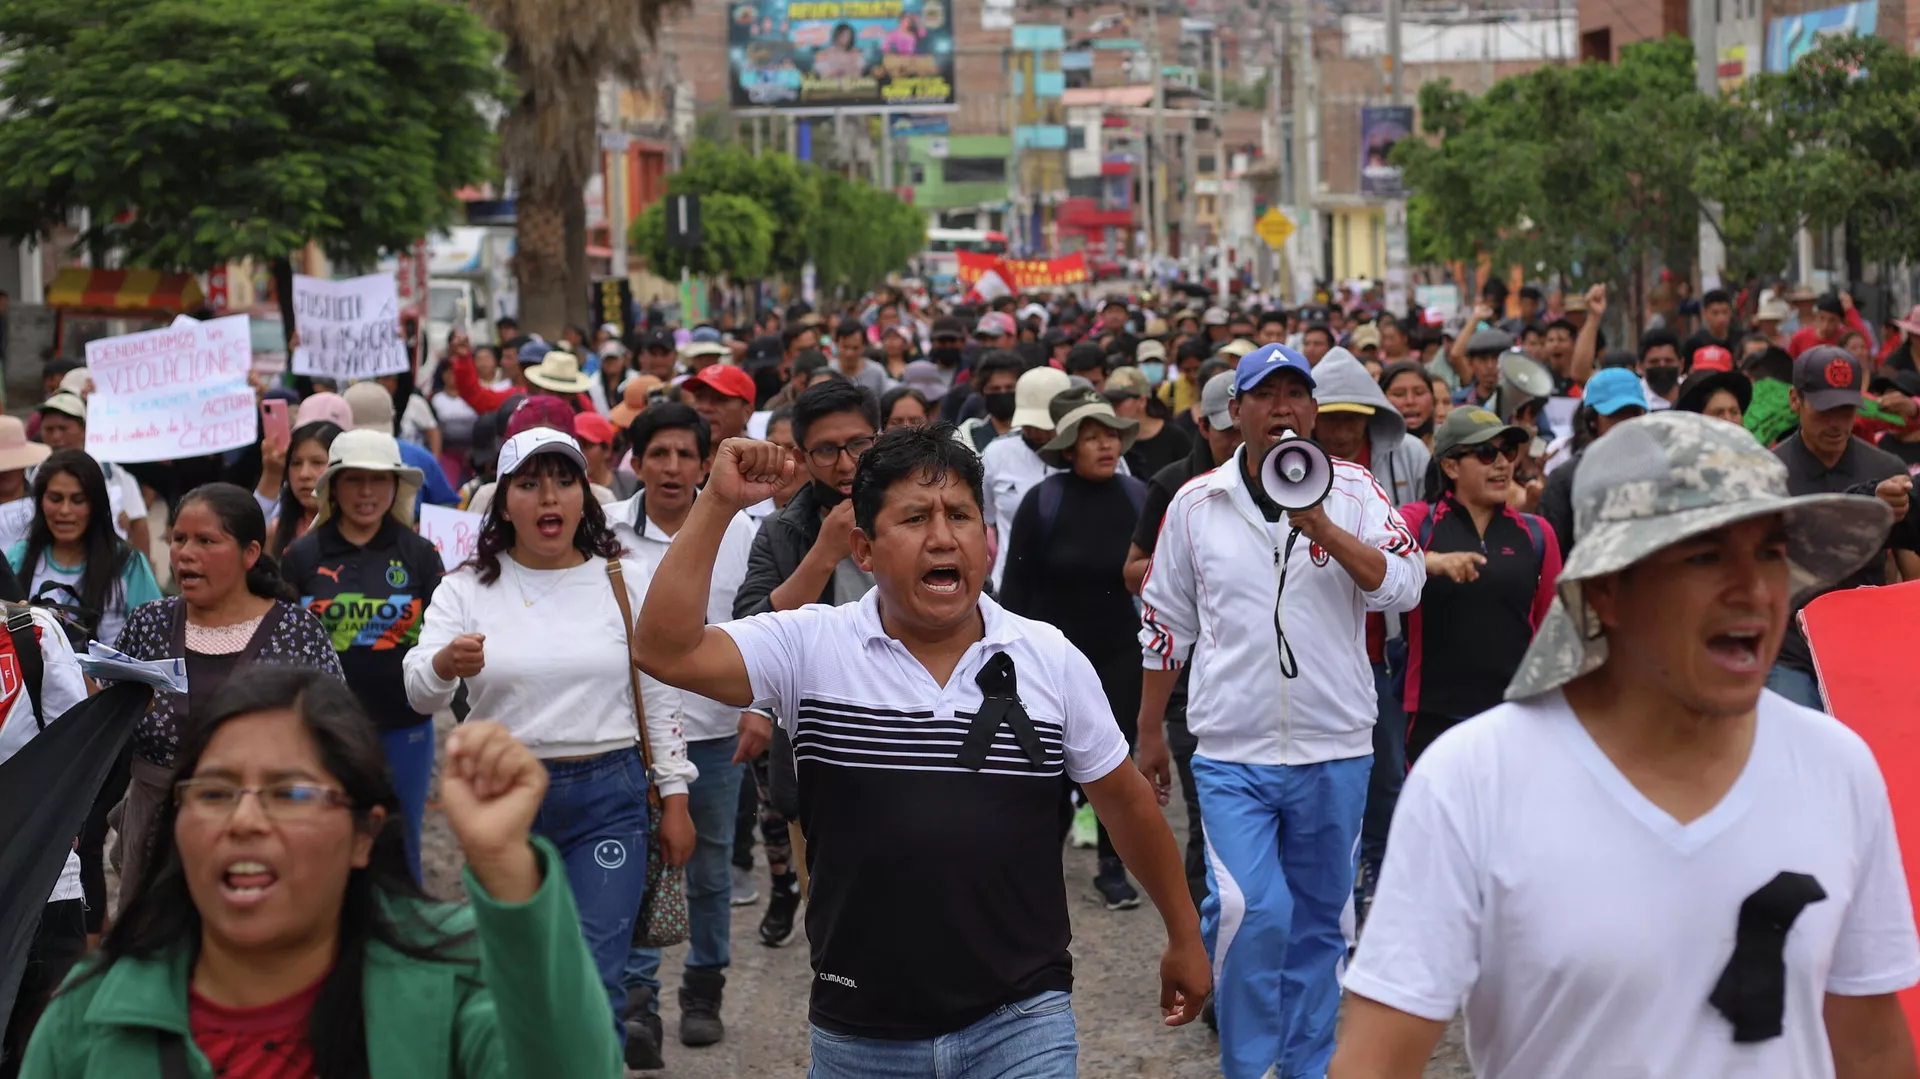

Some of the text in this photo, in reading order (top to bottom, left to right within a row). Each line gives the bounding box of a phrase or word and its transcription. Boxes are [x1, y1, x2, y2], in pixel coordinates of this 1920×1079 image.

[106, 338, 250, 395] VIOLACIONES
[310, 602, 413, 620] SOMOS
[820, 973, 857, 988] CLIMACOOL
